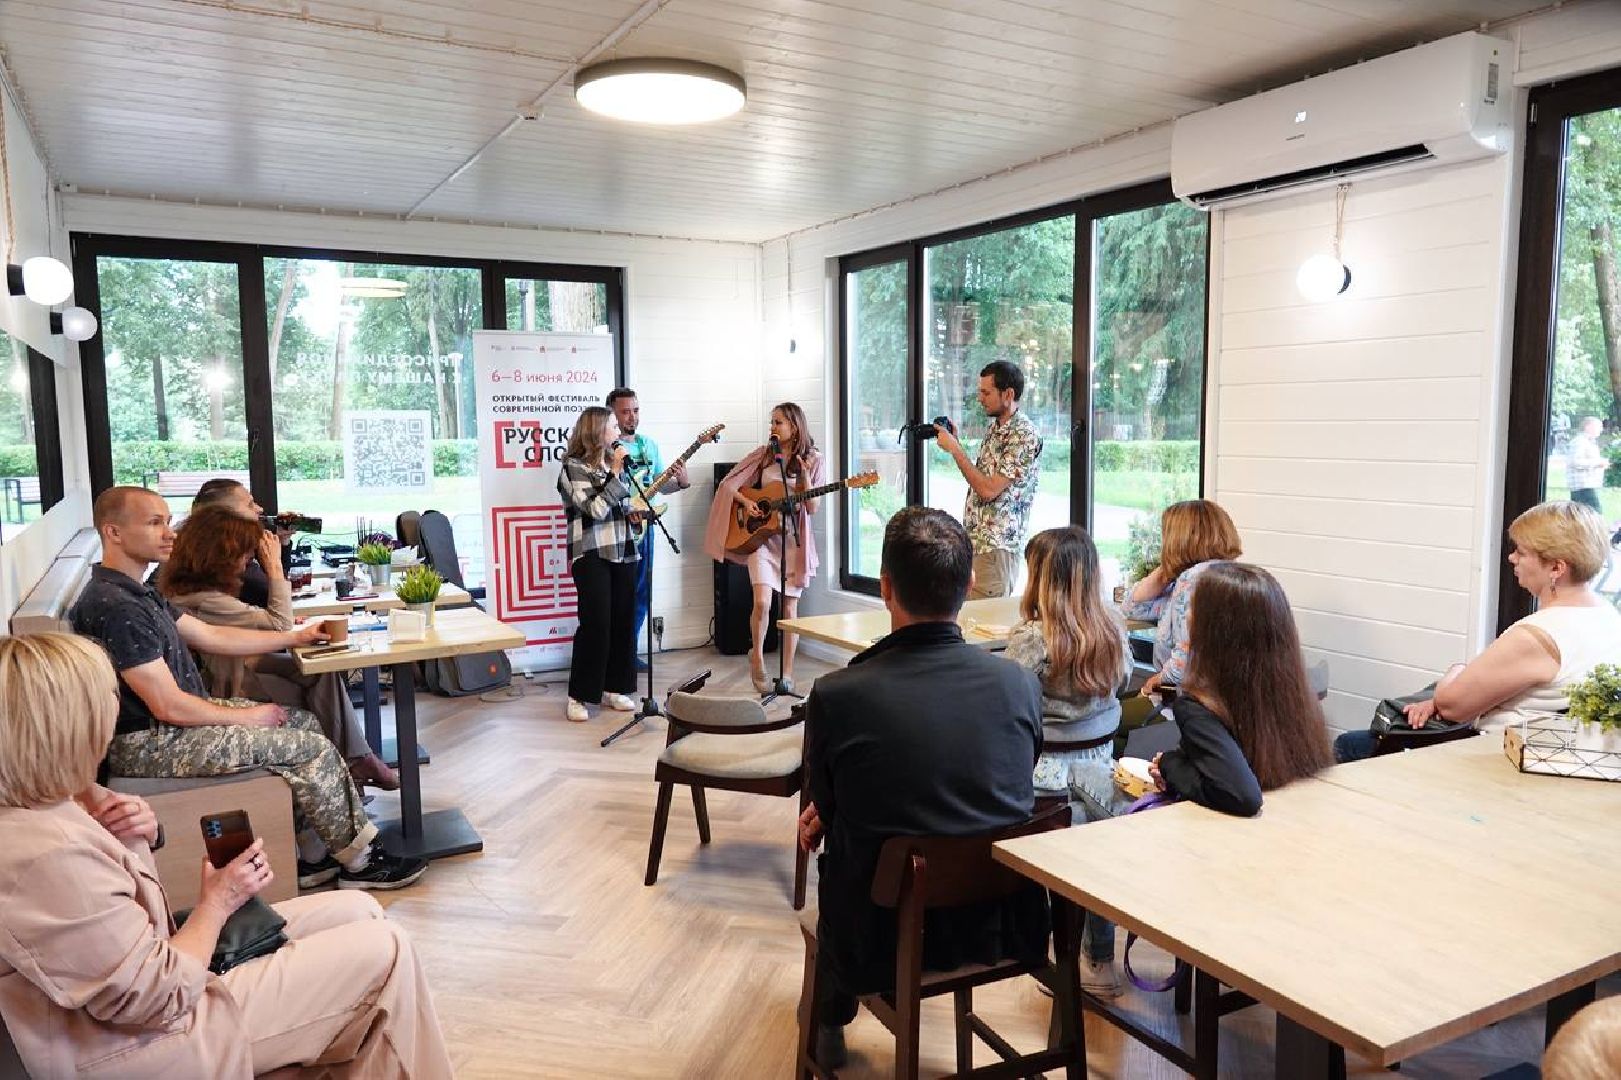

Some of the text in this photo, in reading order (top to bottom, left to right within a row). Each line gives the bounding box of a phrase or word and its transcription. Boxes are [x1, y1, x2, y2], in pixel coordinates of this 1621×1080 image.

[527, 374, 563, 383] июня
[566, 370, 598, 383] 2024
[492, 393, 600, 403] ОТКРЫТЫЙ ФЕСТИВАЛЬ
[492, 404, 585, 413] СОВРЕМЕННОЙ ПОЭ
[504, 428, 573, 444] РУССК
